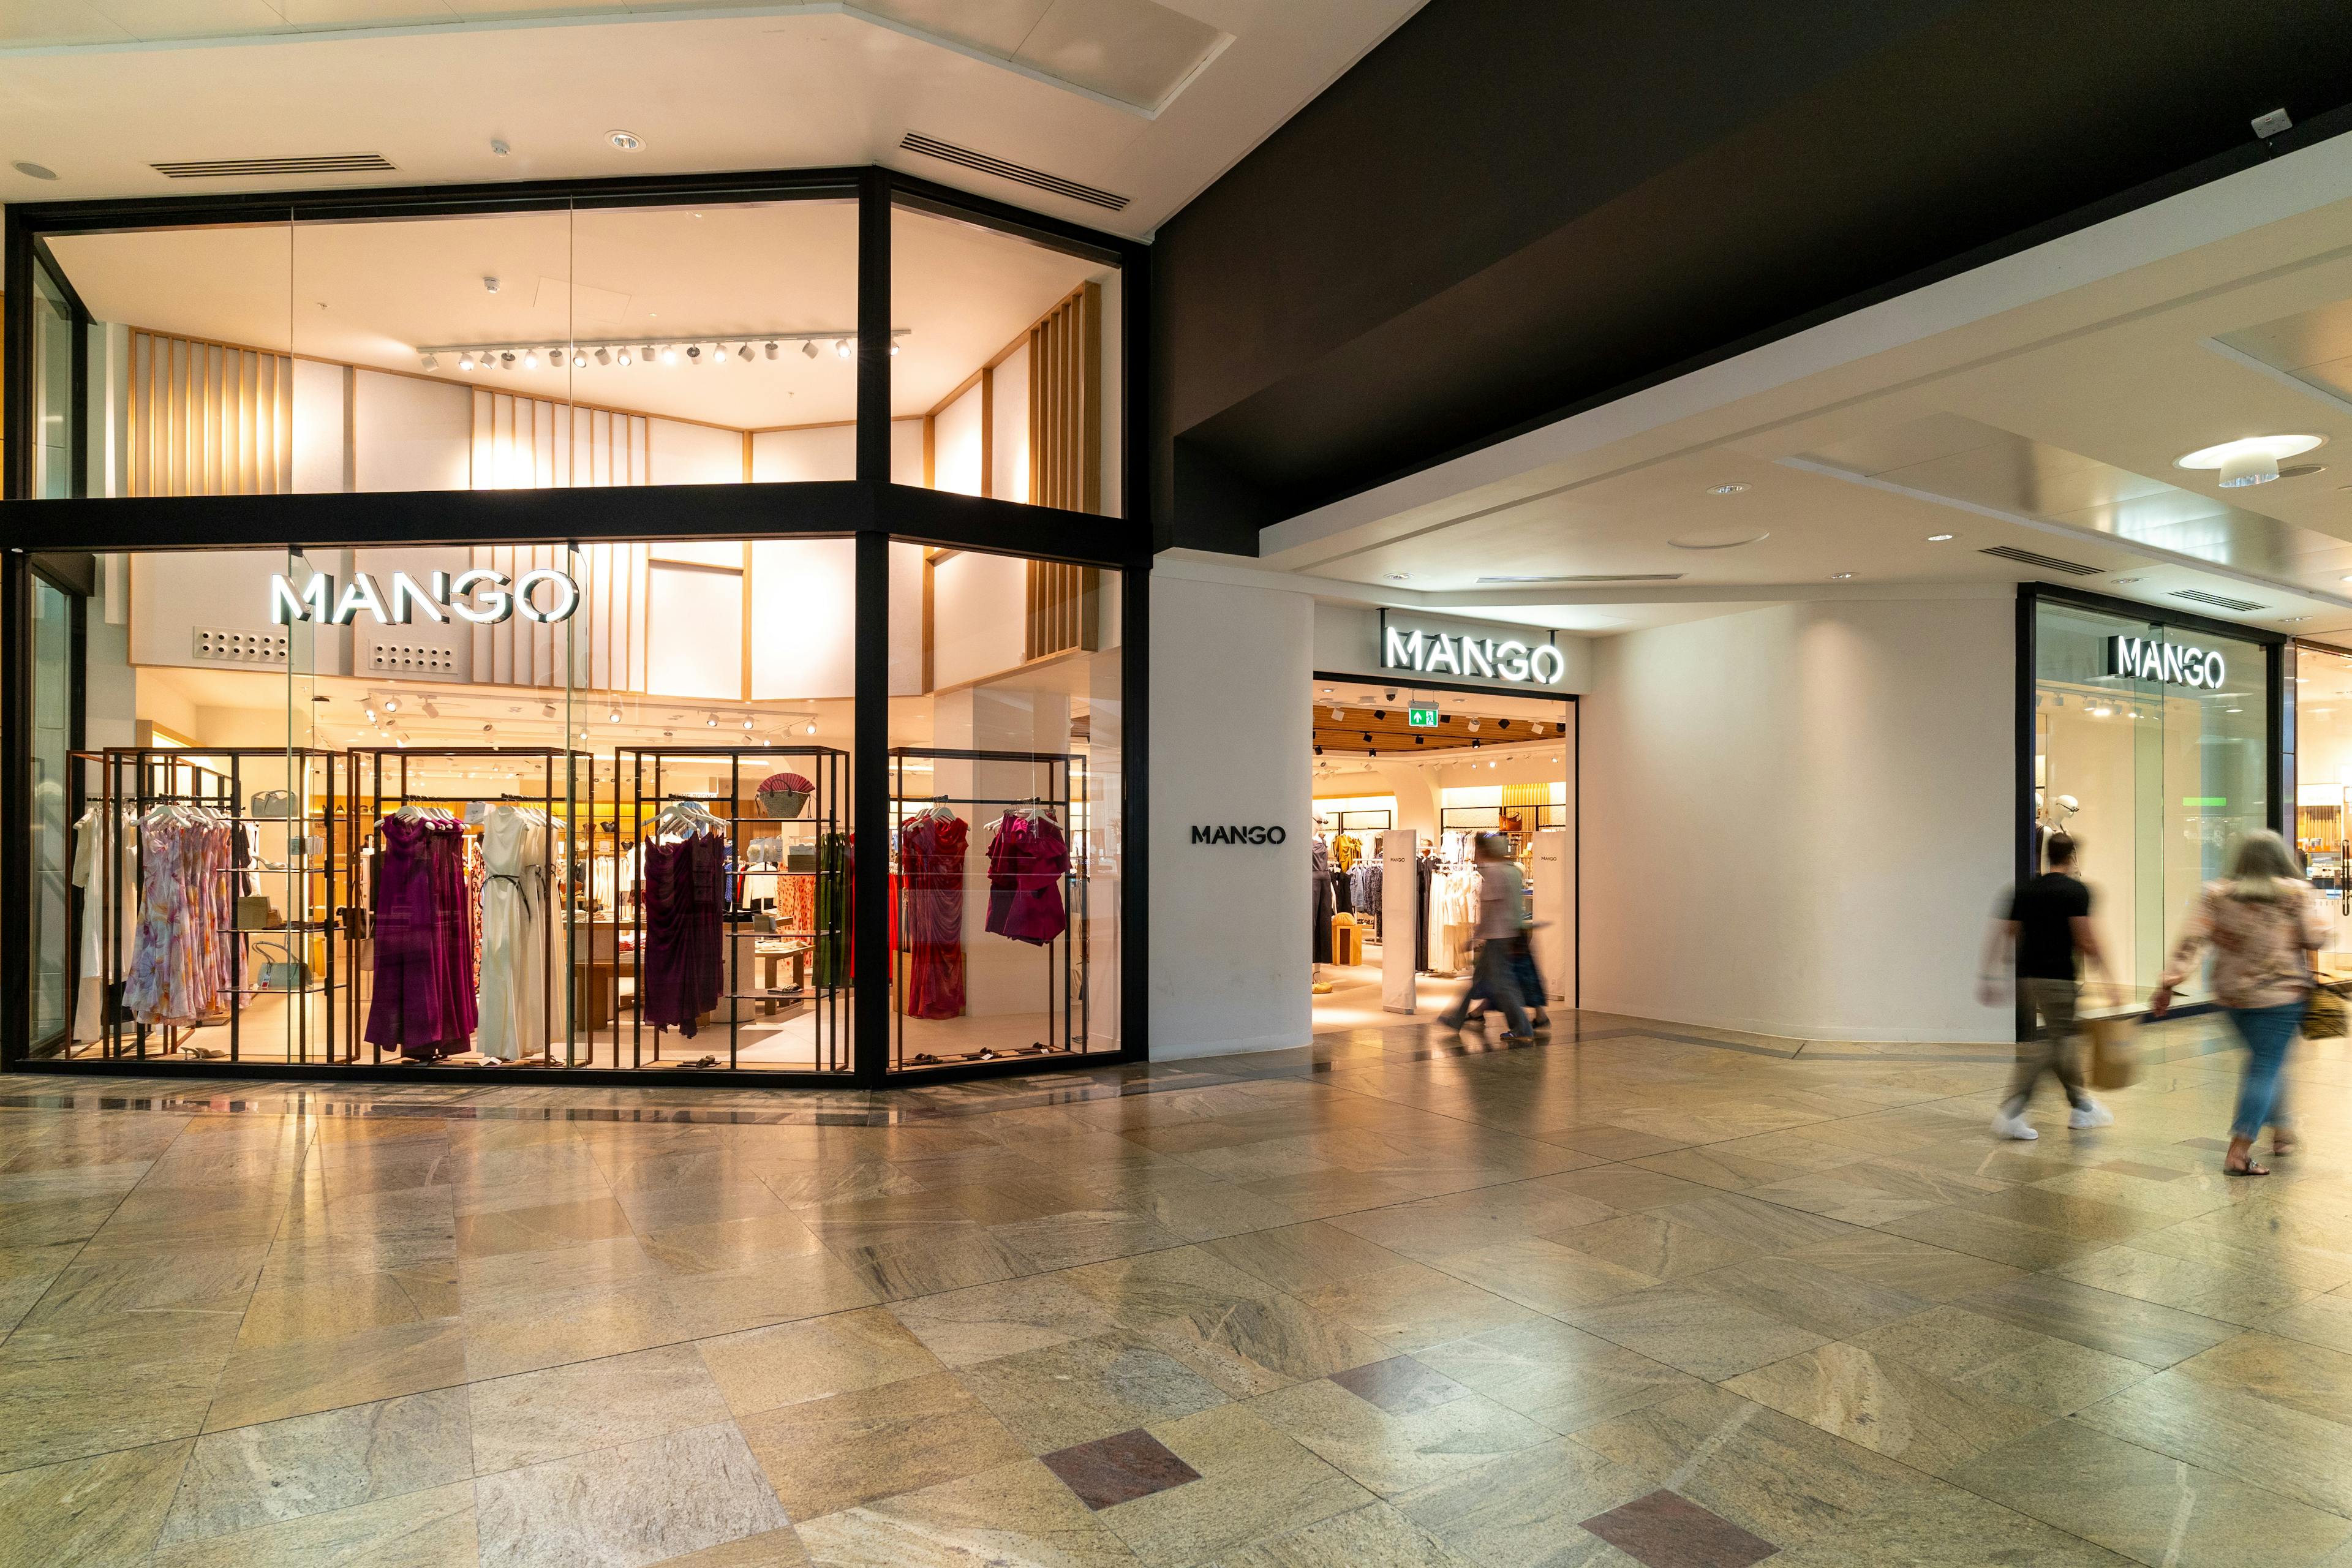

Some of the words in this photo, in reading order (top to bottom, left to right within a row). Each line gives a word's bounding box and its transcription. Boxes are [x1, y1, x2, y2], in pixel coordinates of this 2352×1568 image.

[272, 569, 579, 625] MANGO
[1386, 627, 1564, 684] MANGO
[2117, 635, 2225, 688] MANGO
[1192, 826, 1286, 845] MANGO
